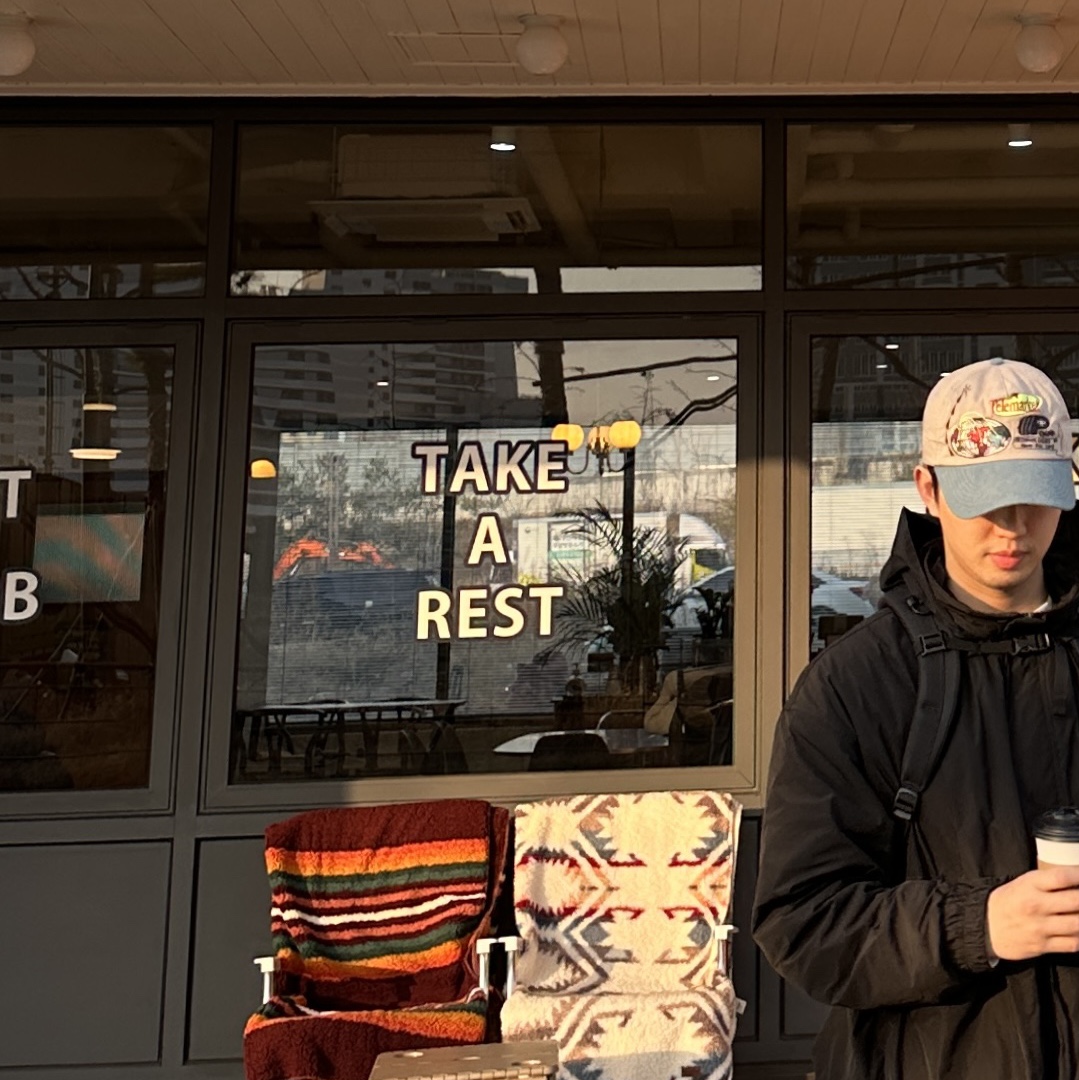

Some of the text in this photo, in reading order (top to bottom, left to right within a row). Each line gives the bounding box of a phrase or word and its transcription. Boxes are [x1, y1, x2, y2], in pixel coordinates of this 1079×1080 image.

[414, 442, 567, 493] TAKE
[467, 515, 507, 564] A
[3, 571, 39, 620] B
[416, 586, 564, 640] REST
